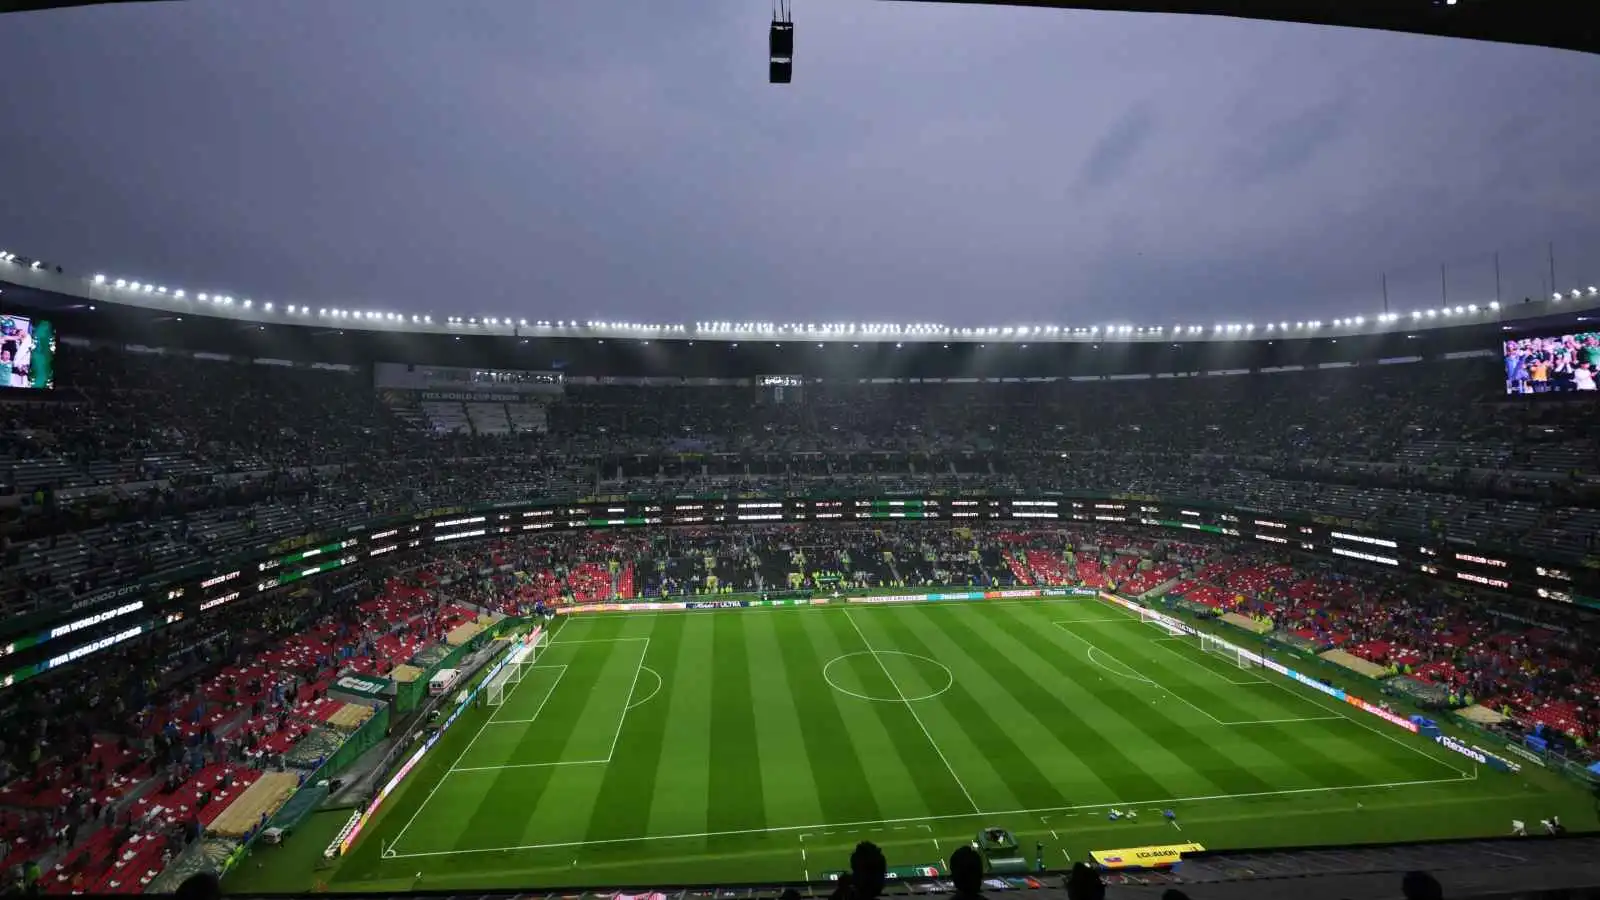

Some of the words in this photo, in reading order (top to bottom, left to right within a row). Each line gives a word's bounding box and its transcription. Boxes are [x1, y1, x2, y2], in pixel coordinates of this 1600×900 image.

[51, 624, 71, 639] FIFA
[70, 615, 101, 631] WORLD
[100, 609, 117, 621] CUP
[49, 653, 69, 668] FIFA
[69, 642, 100, 660] WORLD
[99, 636, 116, 648] CUP
[1442, 736, 1487, 764] Rexona
